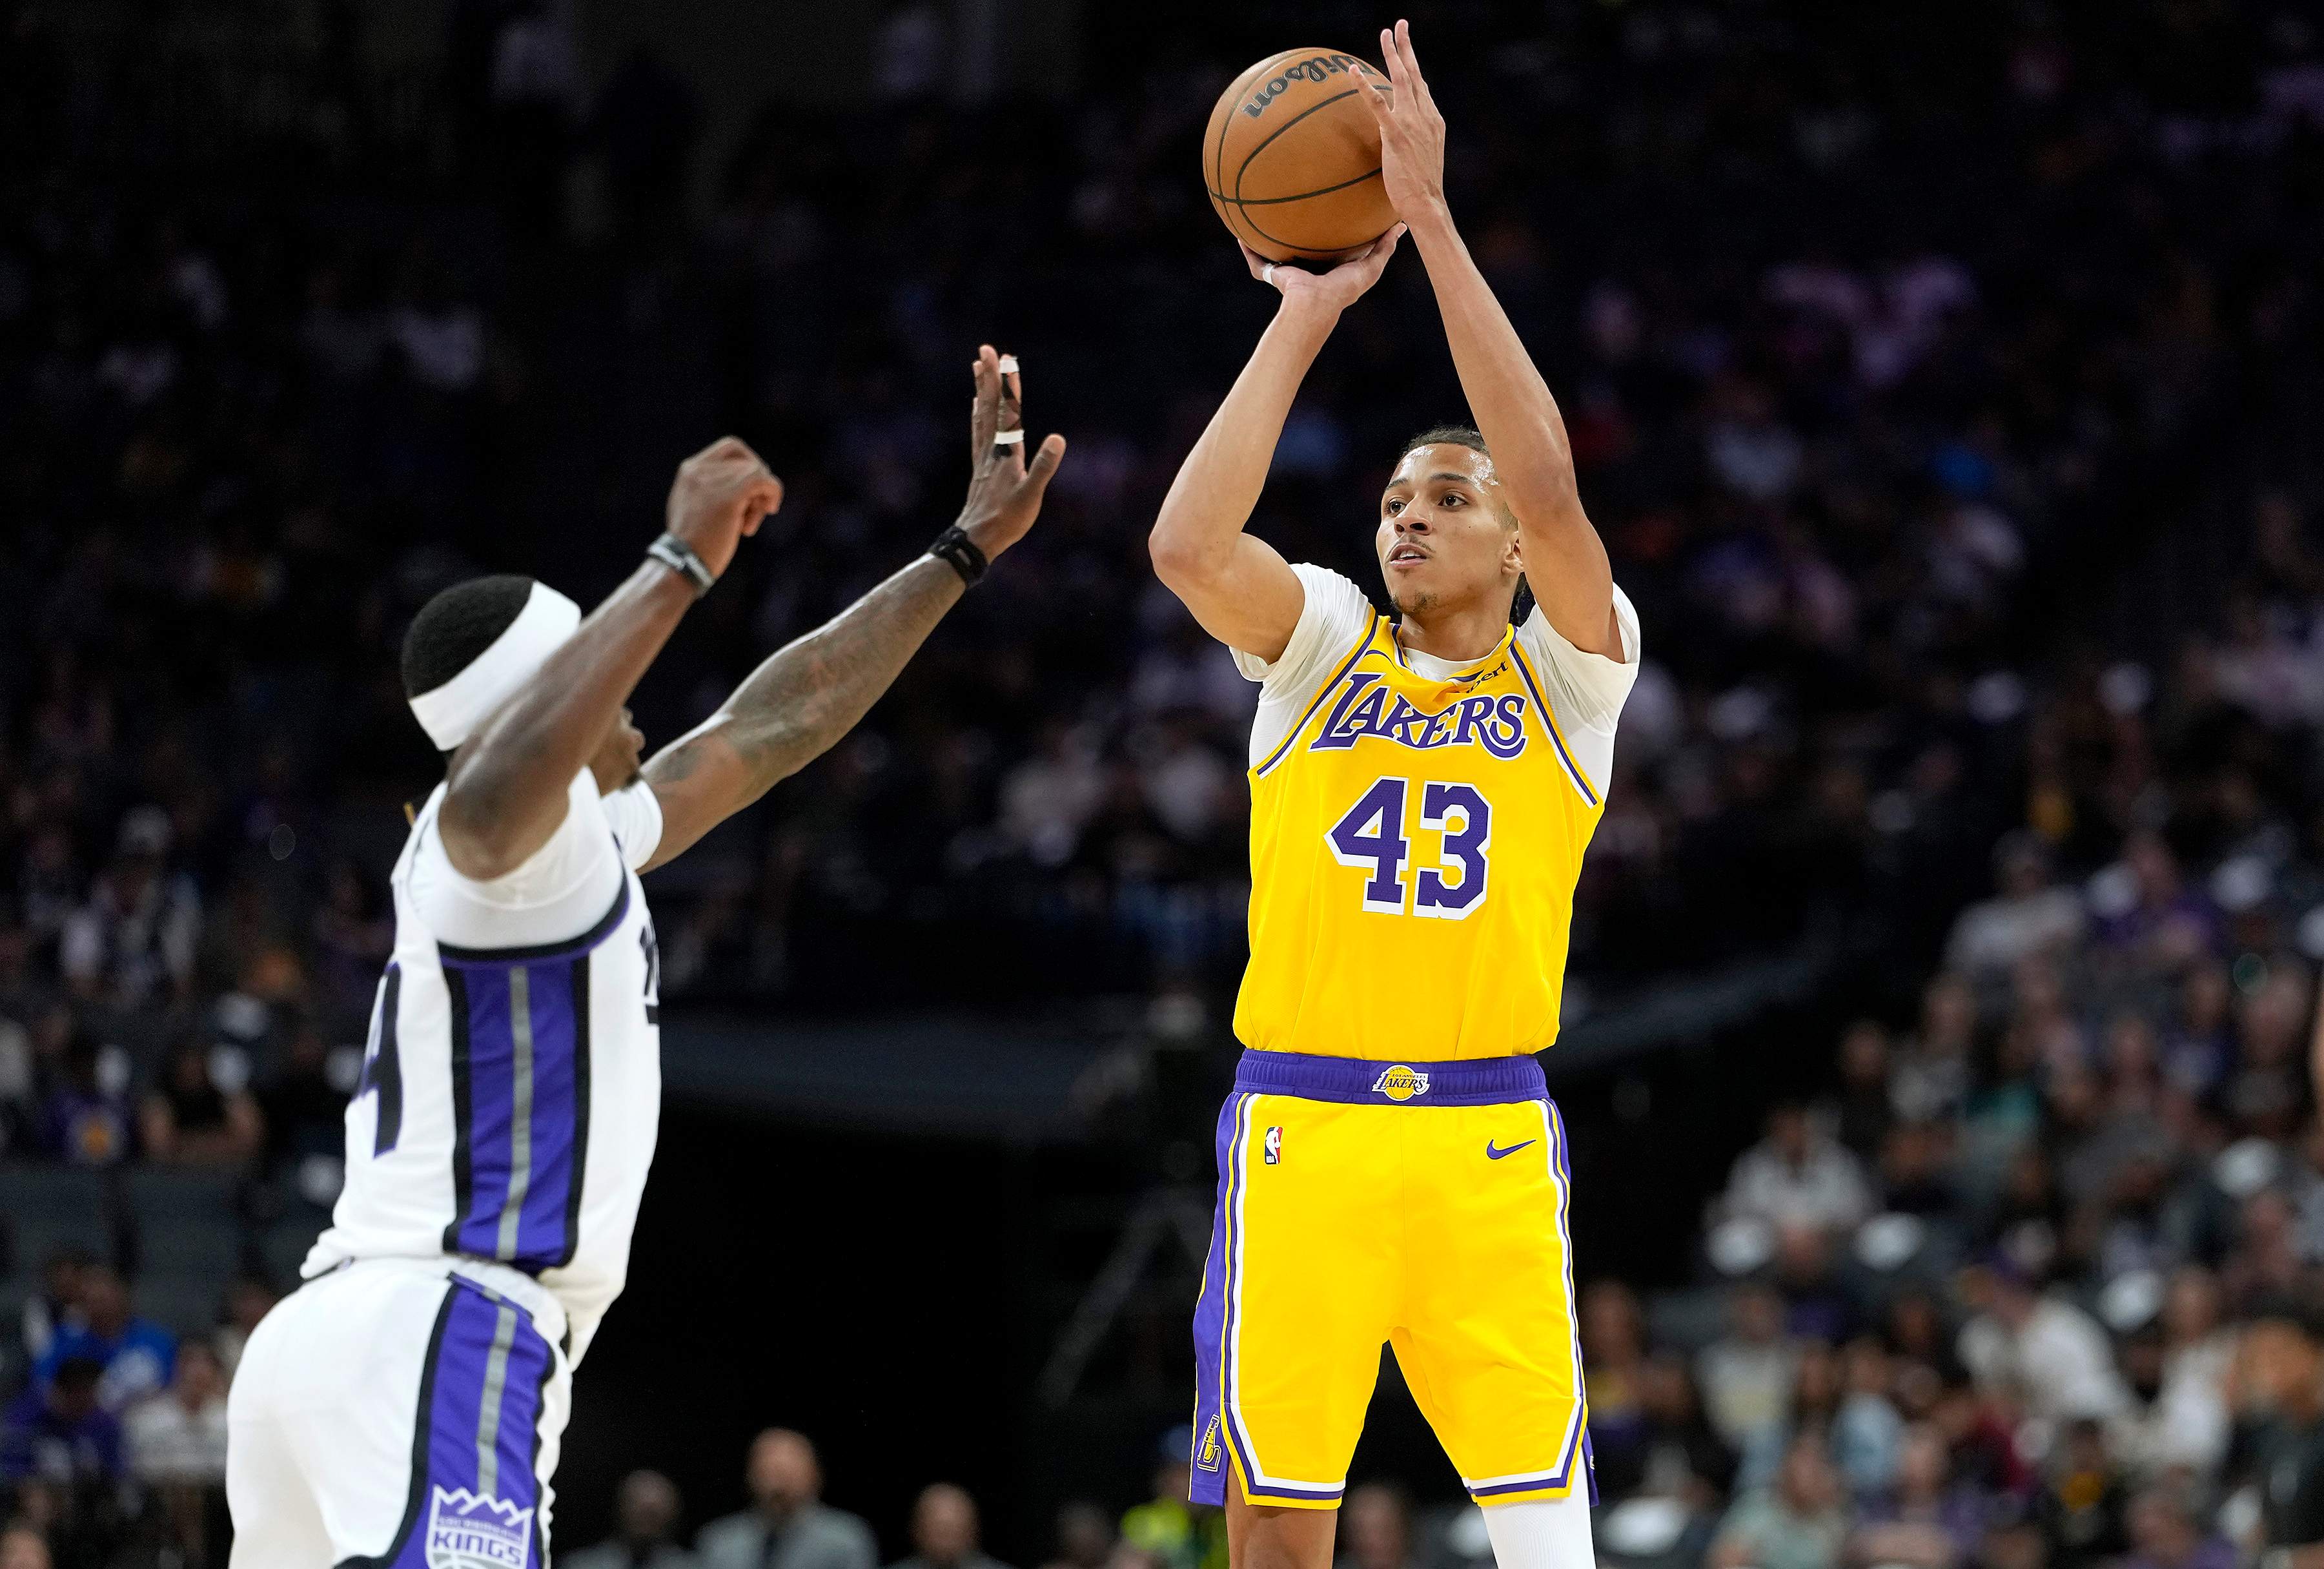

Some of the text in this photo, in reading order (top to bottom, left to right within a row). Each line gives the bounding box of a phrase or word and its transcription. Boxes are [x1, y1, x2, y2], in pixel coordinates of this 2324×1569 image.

[1308, 672, 1528, 761] LAKERS
[1324, 775, 1493, 921] 43
[1374, 1073, 1429, 1093] LAKERS
[433, 1531, 522, 1566] KINGS
